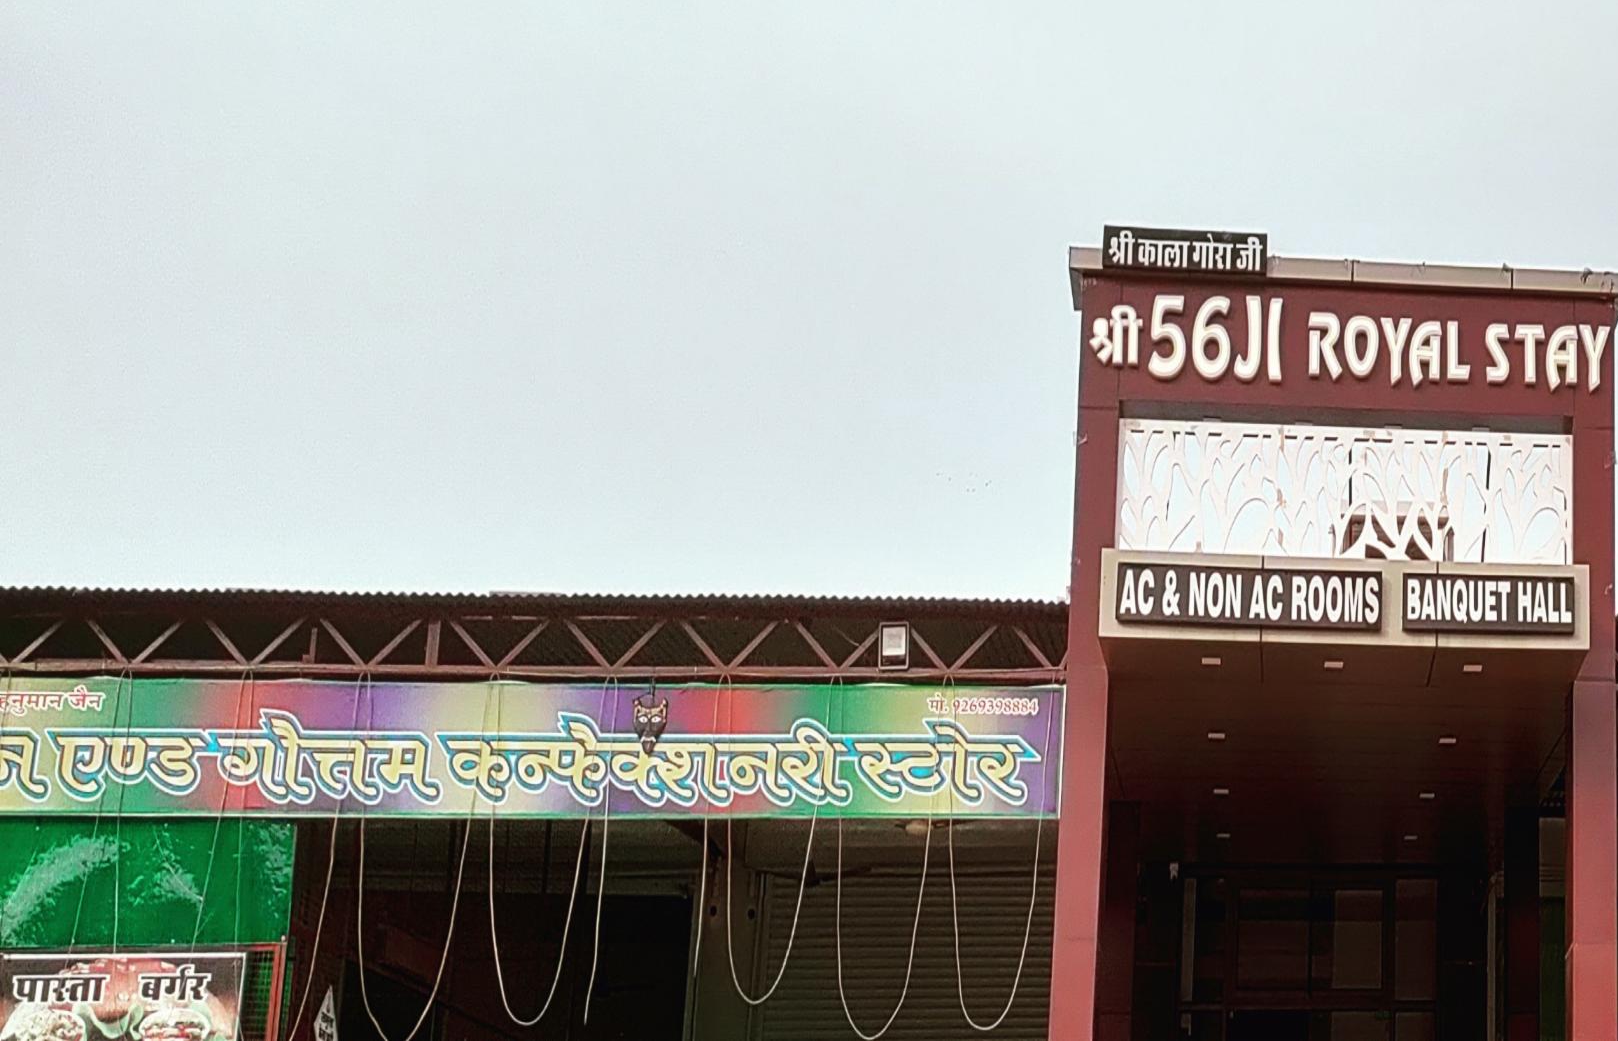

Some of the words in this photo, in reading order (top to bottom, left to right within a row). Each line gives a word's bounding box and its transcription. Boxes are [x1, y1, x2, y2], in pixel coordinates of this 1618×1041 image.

[1108, 230, 1135, 265] श्री
[1137, 239, 1190, 268] काला
[1193, 233, 1233, 270] गोरा
[1236, 237, 1263, 271] जी
[1089, 305, 1143, 368] श्री
[1148, 294, 1284, 383] 56JI
[1308, 311, 1470, 386] ROYAL
[1484, 323, 1611, 392] STAY
[1119, 568, 1155, 616] AC
[1162, 570, 1180, 616] &
[1188, 571, 1243, 618] NON
[1249, 574, 1284, 621] AC
[1291, 575, 1380, 624] ROOMS
[1407, 578, 1510, 624] BANQUET
[1517, 581, 1572, 623] HALL
[66, 685, 106, 711] जैन
[952, 697, 1039, 715] 9269398884
[45, 728, 206, 802] एण्ड
[850, 719, 1041, 805] स्टोर
[13, 973, 110, 1003] पास्ता
[138, 963, 211, 1001] बर्गर
